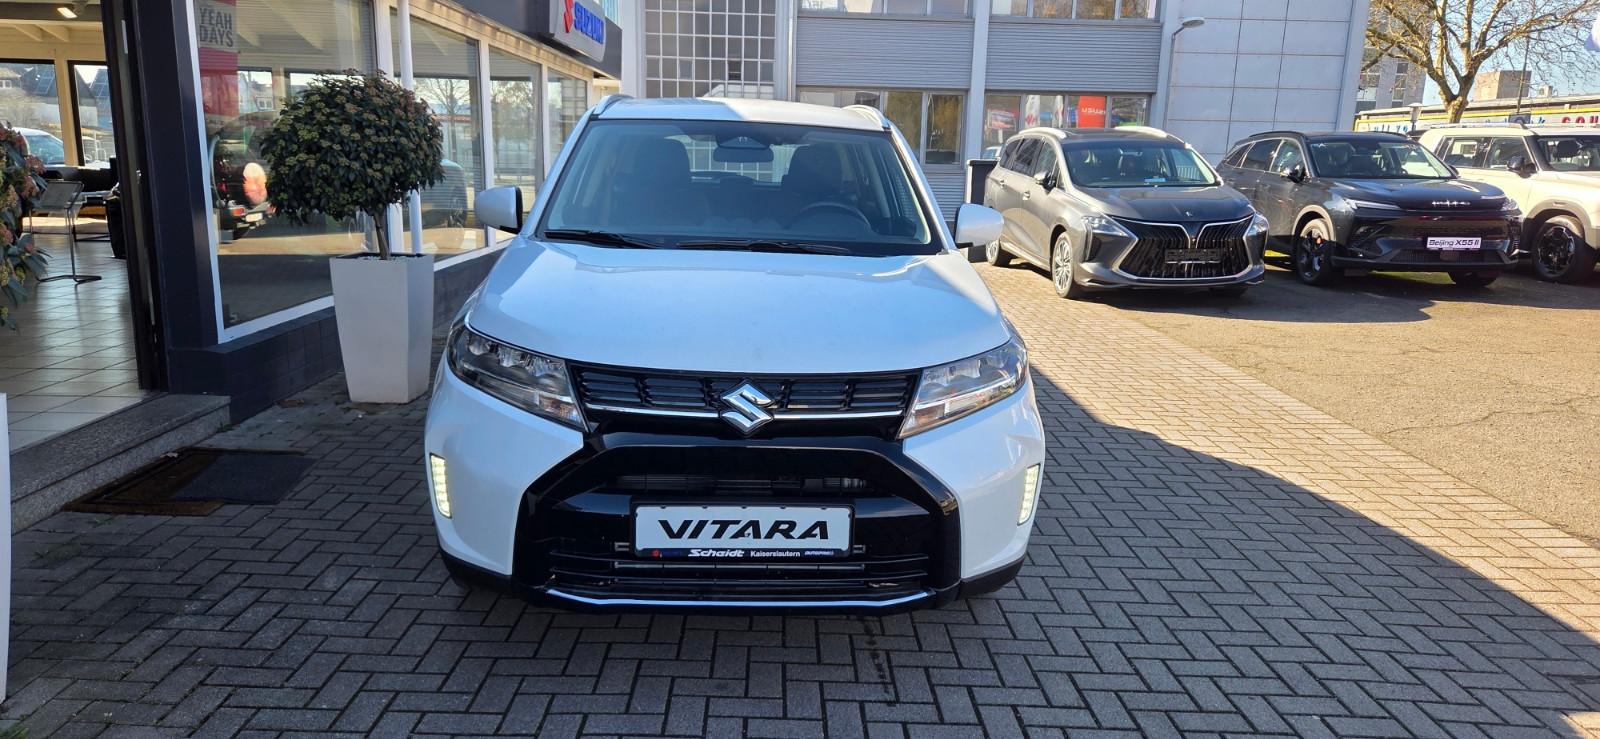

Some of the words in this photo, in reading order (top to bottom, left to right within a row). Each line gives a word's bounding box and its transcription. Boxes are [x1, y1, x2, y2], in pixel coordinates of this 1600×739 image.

[199, 7, 232, 30] YEAH
[574, 2, 604, 44] SUZUKI
[199, 25, 233, 47] DAYS
[658, 519, 829, 540] VITARA
